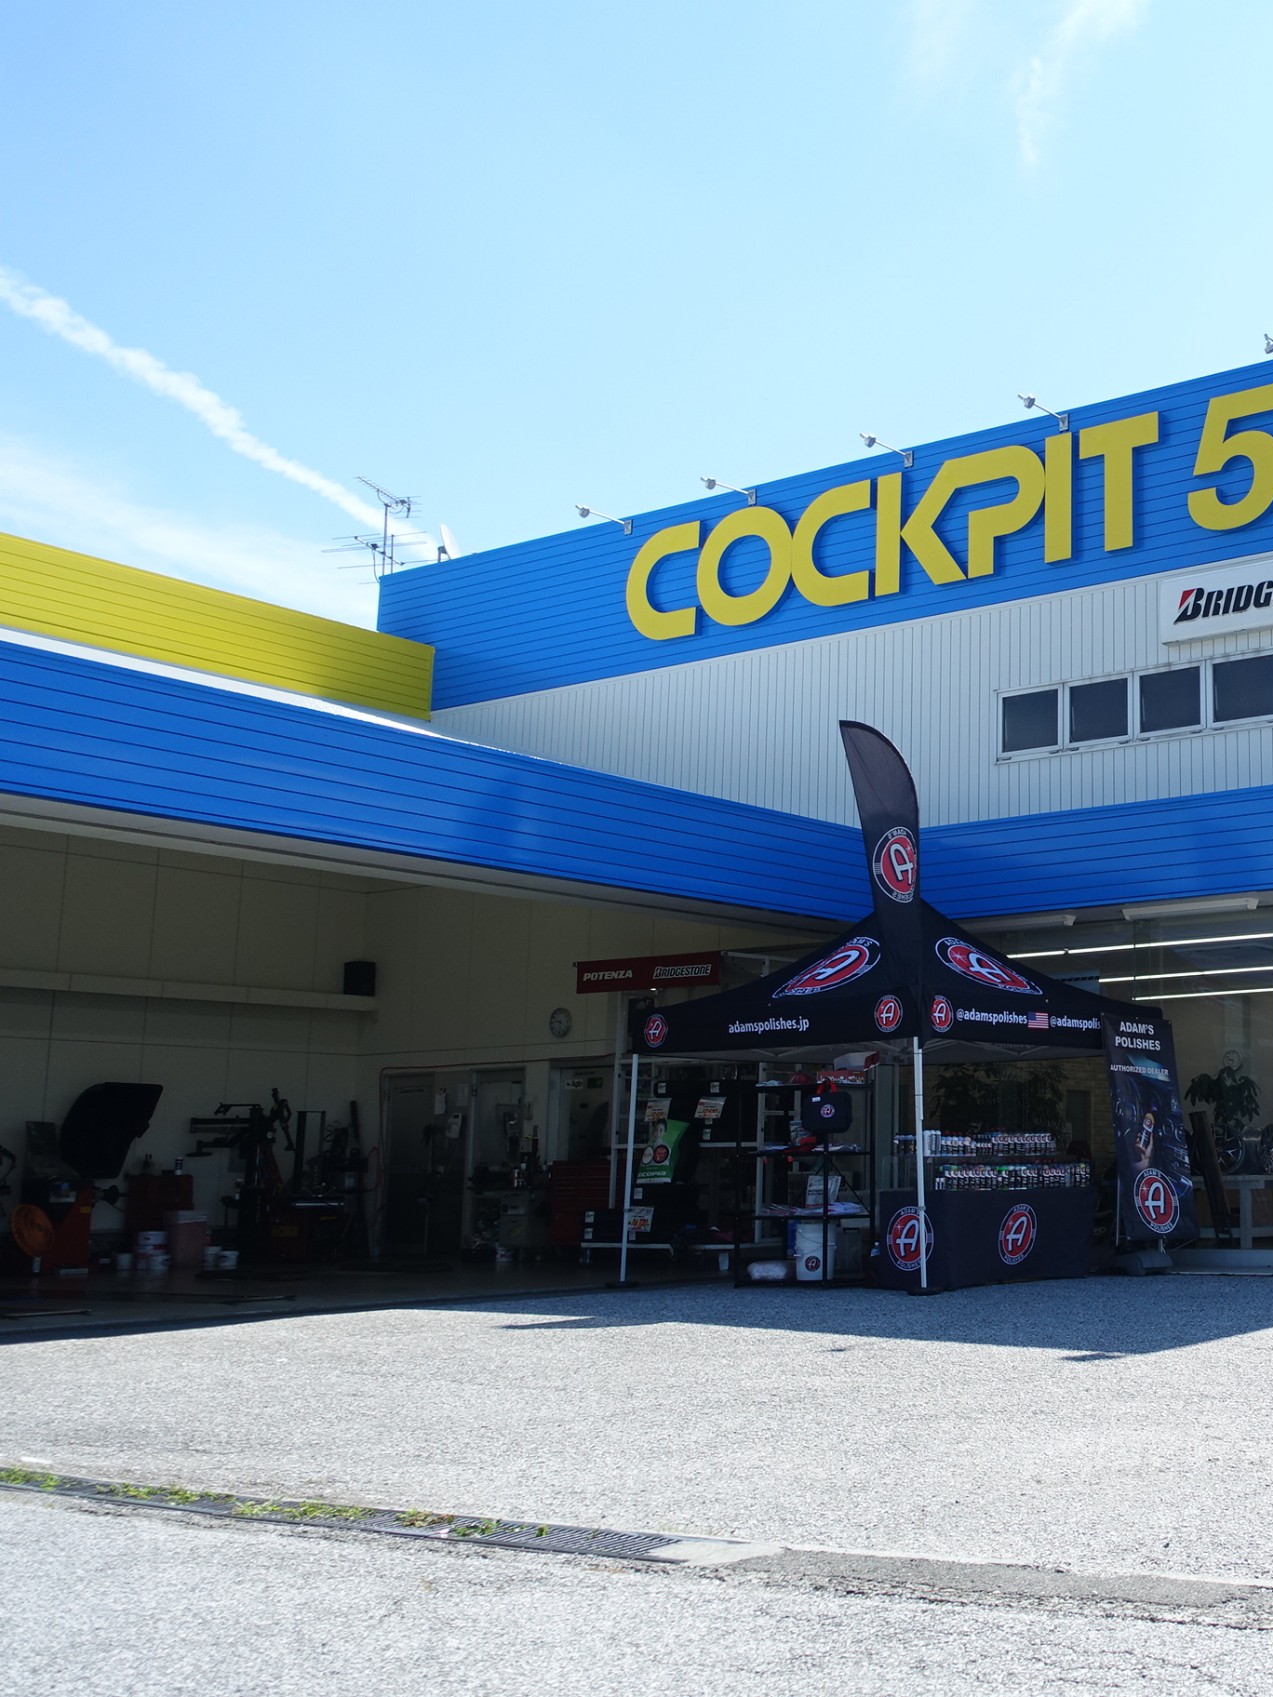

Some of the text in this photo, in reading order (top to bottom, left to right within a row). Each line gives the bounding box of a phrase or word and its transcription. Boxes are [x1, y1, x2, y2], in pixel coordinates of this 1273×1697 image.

[625, 411, 1160, 641] COCKPIT
[582, 964, 712, 982] POTENZA BRIDGESTONE
[728, 1015, 810, 1035] adamspolishes.jp
[956, 1008, 1101, 1032] @adamspolishes @adamspolis
[1119, 1021, 1155, 1036] ADAM'S
[1115, 1036, 1161, 1051] POLISHES
[1110, 1064, 1170, 1077] AUTHORIZED DEALER
